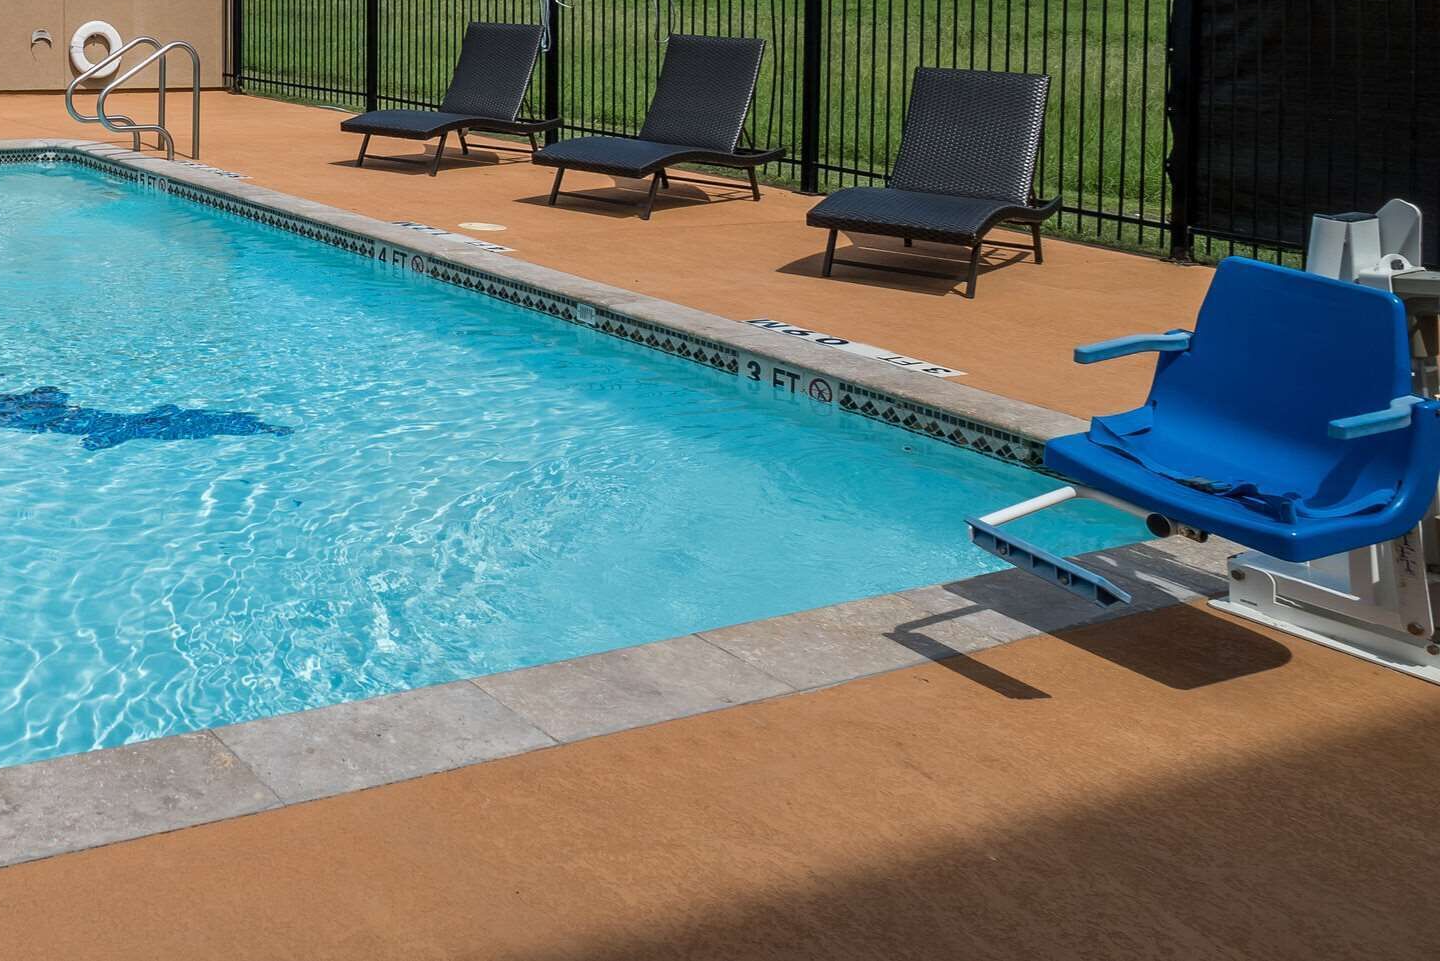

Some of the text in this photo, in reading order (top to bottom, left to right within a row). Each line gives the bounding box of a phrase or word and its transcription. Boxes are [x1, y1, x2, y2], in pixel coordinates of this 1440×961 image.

[377, 247, 408, 269] 4 FT
[747, 360, 801, 394] 3 FT
